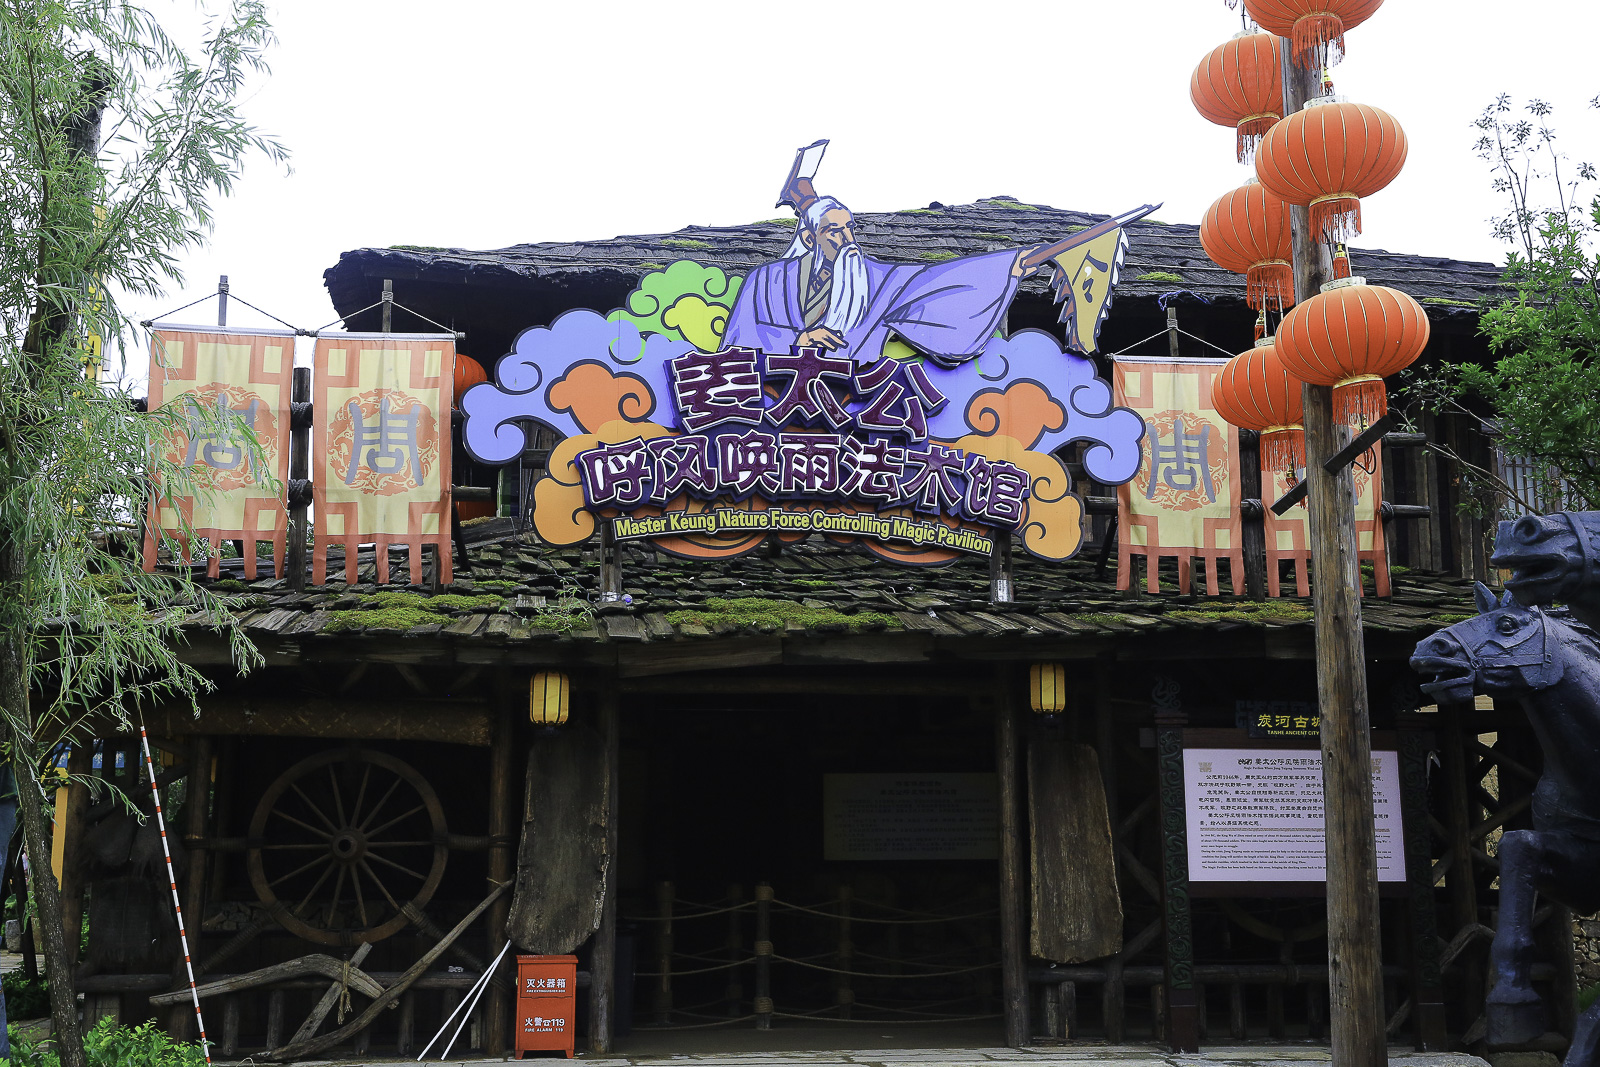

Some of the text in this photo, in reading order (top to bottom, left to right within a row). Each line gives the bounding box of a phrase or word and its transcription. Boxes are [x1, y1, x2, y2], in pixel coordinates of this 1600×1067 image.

[672, 346, 947, 442] 姜太公
[344, 398, 424, 487] 周
[580, 430, 1031, 524] 呼风唤雨法术馆
[1146, 419, 1216, 503] 周
[616, 511, 992, 553] Master Keung Nature Force Controlling Magic Pavilion
[525, 1017, 565, 1026] 火警 119
[526, 978, 566, 988] 灭火器箱
